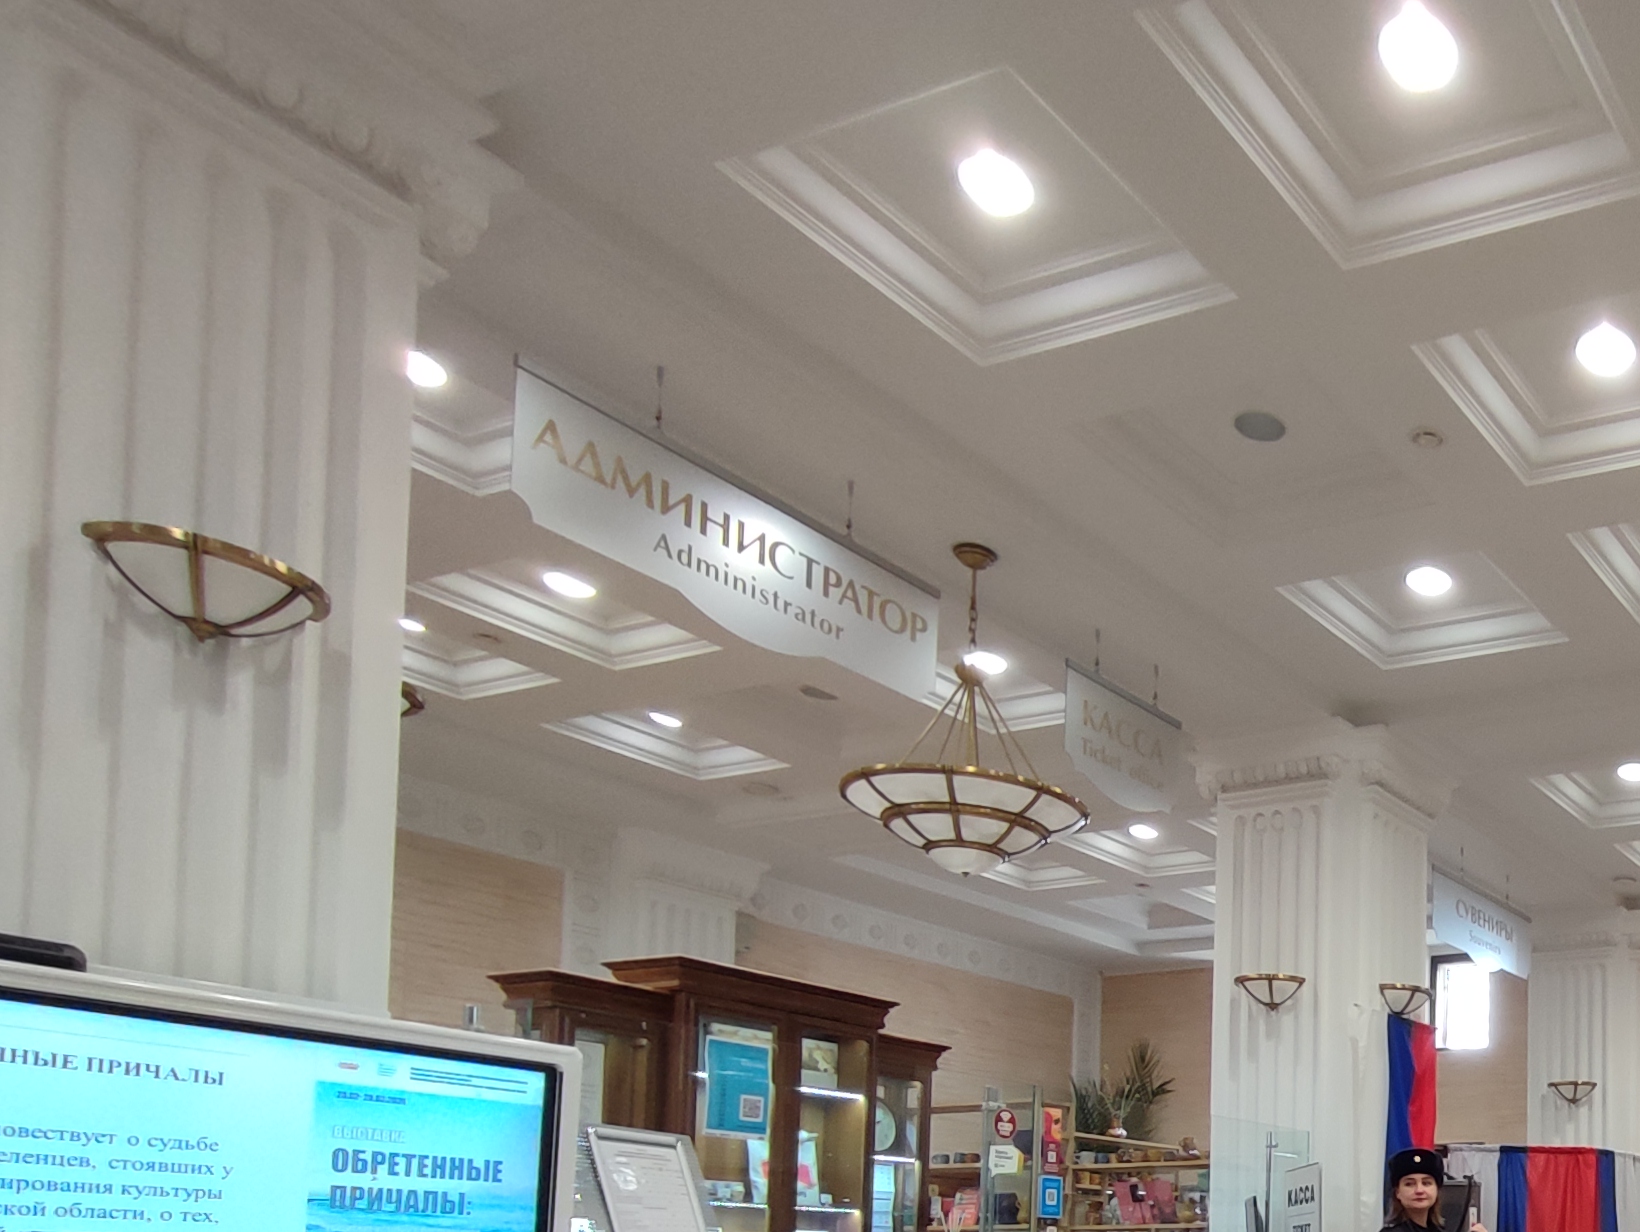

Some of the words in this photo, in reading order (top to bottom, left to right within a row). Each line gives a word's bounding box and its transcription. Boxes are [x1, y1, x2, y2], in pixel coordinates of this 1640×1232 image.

[532, 419, 928, 643] АДМИНИСТРАТОР
[653, 533, 845, 641] Administrator
[1082, 699, 1164, 766] КАССА
[1455, 899, 1514, 942] СУВЕНИРЫ
[86, 1056, 225, 1086] ПРИЧАЛЫ
[0, 1125, 117, 1146] овествует
[127, 1134, 140, 1147] о
[147, 1136, 219, 1152] судьбе
[332, 1124, 406, 1144] ВЫСТАВКА
[108, 1157, 215, 1176] стоявших
[221, 1165, 234, 1180] у
[331, 1147, 504, 1183] ОБРЕТЕННЫЕ
[120, 1183, 223, 1203] культуры
[329, 1185, 472, 1215] ПРИЧАЛЫ:
[1287, 1184, 1315, 1208] КАССА
[0, 1201, 47, 1217] кой
[53, 1203, 152, 1222] области,
[159, 1210, 173, 1222] о
[179, 1211, 219, 1224] тех,
